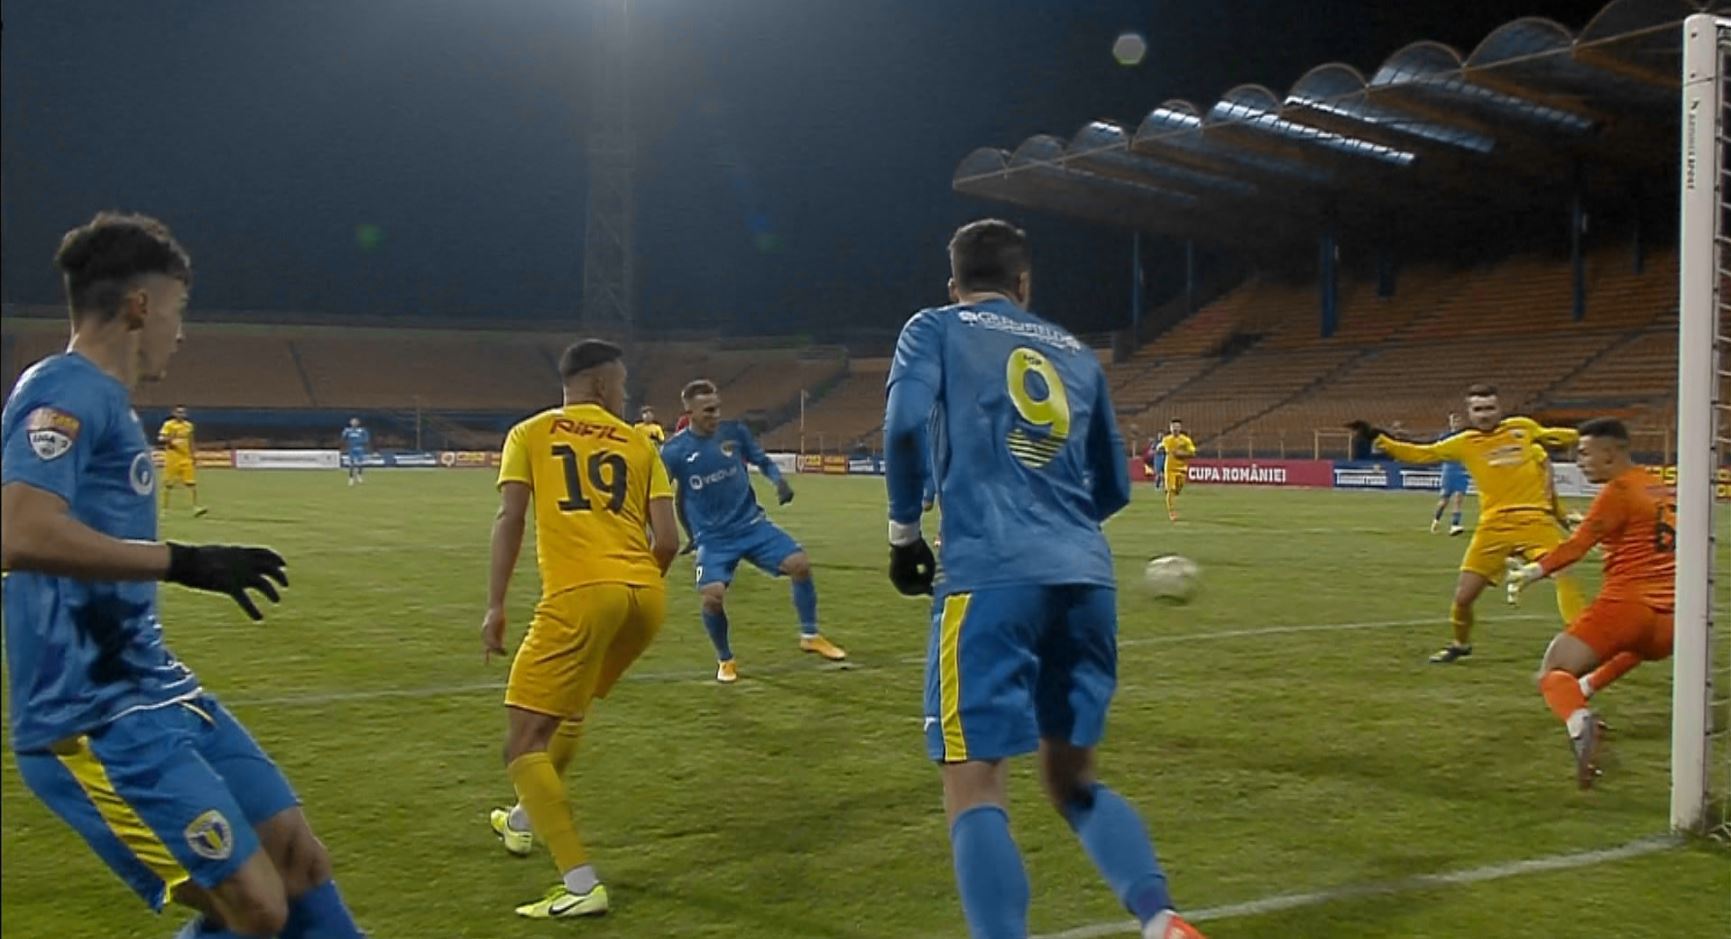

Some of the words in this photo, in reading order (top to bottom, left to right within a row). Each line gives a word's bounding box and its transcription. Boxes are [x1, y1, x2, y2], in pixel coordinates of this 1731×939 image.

[1005, 346, 1071, 468] 9
[551, 444, 628, 515] 19
[1188, 466, 1220, 481] CUPA
[1222, 463, 1286, 483] ROMÂNIEI
